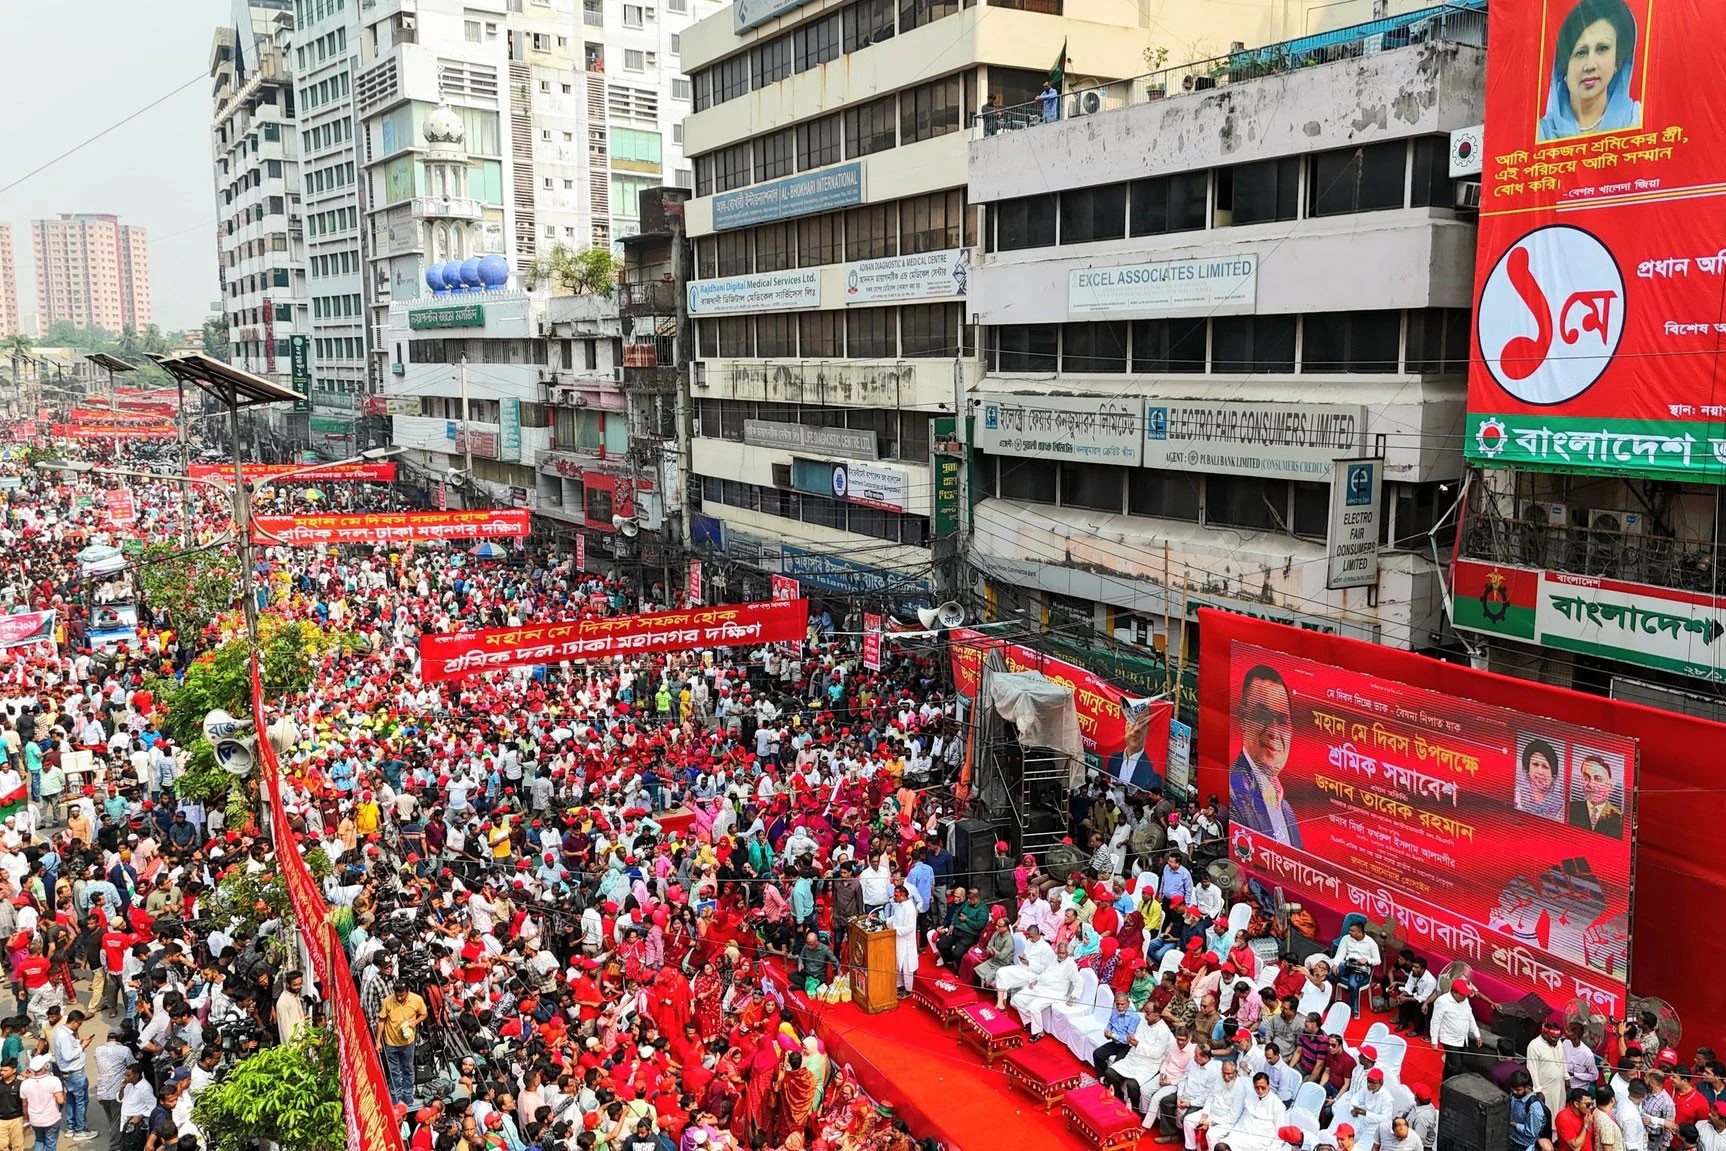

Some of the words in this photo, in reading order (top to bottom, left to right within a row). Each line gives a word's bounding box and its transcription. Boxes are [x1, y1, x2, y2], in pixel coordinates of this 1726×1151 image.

[1495, 150, 1528, 167] আমি
[1533, 143, 1587, 162] একজন
[1591, 131, 1657, 154] শ্রমিকের
[1662, 125, 1689, 144] স্ত্রী,
[1494, 167, 1518, 182] এই
[1523, 160, 1576, 179] পরিচয়ে
[1581, 153, 1618, 170] আমি
[1622, 146, 1673, 165] সম্মান
[816, 170, 858, 193] INTERNATIONAL
[1493, 181, 1524, 198] বোধ
[1528, 176, 1561, 193] করি।
[1598, 181, 1631, 193] খালেদা
[1634, 178, 1661, 191] জিয়া
[860, 263, 875, 272] ADNAN
[875, 260, 901, 271] DIAGNOSTIC
[902, 260, 906, 268] &
[906, 257, 927, 268] MEDICAL
[927, 254, 947, 265] CENTRE
[1079, 272, 1114, 288] EXCEL
[1117, 265, 1194, 285] ASSOCIATES
[1199, 260, 1252, 279] LIMITED
[1636, 258, 1690, 280] প্রধান
[700, 283, 725, 295] Rajdhani
[726, 281, 746, 293] Digital
[747, 277, 772, 289] Medical
[774, 275, 801, 287] Services
[802, 273, 816, 283] Ltd.
[1500, 246, 1553, 380] ১
[1559, 290, 1618, 346] মে
[1664, 321, 1708, 336] বিশেষ
[1098, 403, 1136, 437] লিমিটেড
[1169, 408, 1213, 442] ELECTRO
[1215, 411, 1237, 444] FAIR
[1240, 411, 1307, 448] CONSUMERS
[1309, 413, 1355, 450] LIMITED
[804, 432, 814, 443] LIFE
[813, 433, 841, 447] DIAGNOSTIC
[841, 436, 861, 449] CENTRE
[861, 438, 872, 451] LTD.
[1511, 426, 1697, 467] বাংলাদেশ
[1200, 455, 1220, 466] PUBALI
[1220, 456, 1236, 468] BANK
[1236, 458, 1260, 469] LIMITED
[1261, 459, 1299, 473] (CONSUMERS
[1300, 460, 1323, 474] CREDIT
[277, 525, 333, 540] শ্রমিক
[337, 525, 414, 540] দল-ঢাকা
[417, 523, 479, 536] মহানগর
[481, 519, 522, 534] দক্ষিণ
[295, 516, 336, 528] মহান
[341, 518, 361, 527] মে
[365, 514, 406, 525] দিবস
[410, 515, 450, 524] সফল
[453, 512, 489, 523] হোক
[1343, 511, 1373, 525] ELECTRO
[1350, 527, 1365, 540] FAIR
[1336, 542, 1376, 557] CONSUMERS
[1343, 558, 1368, 572] LIMITED
[816, 576, 858, 593] Islamic
[1556, 573, 1602, 588] বাংলাদেশ
[485, 628, 545, 646] মহান
[548, 624, 573, 639] মে
[578, 620, 633, 635] দিবস
[637, 614, 690, 629] সফল
[693, 609, 739, 625] হোক
[1548, 594, 1712, 646] বাংলাদেশ
[444, 649, 512, 674] শ্রমিক
[515, 633, 613, 661] দল-ঢাকা
[616, 627, 700, 649] মহানগর
[704, 620, 763, 641] দক্ষিণ
[1079, 687, 1121, 719] মানুষের
[1327, 688, 1335, 698] মে
[1336, 688, 1353, 704] দিবস
[1373, 702, 1388, 714] ডাক
[1395, 705, 1417, 723] বৈষম্য
[1419, 711, 1443, 728] নিপাত
[1446, 722, 1461, 733] যাক
[1312, 710, 1347, 738] মহান
[1351, 722, 1369, 745] মে
[1372, 721, 1411, 758] দিবস
[1413, 733, 1480, 777] উপলক্ষে
[1328, 742, 1377, 779] শ্রমিক
[1381, 761, 1460, 808] সমাবেশ
[1314, 772, 1356, 802] জনাব
[1359, 788, 1415, 821] তারেক
[1416, 807, 1475, 844] রহমান
[1329, 814, 1347, 827] জনাব
[1349, 818, 1365, 834] মির্জা
[1367, 829, 1392, 843] ফখরুল
[1393, 834, 1419, 854] ইসলাম
[1421, 847, 1456, 868] আলমগীর
[1258, 845, 1342, 899] বাংলাদেশ
[1345, 883, 1487, 961] জাতীয়তাবাদী
[1492, 943, 1565, 992] শ্রমিক
[1570, 976, 1619, 1017] দল
